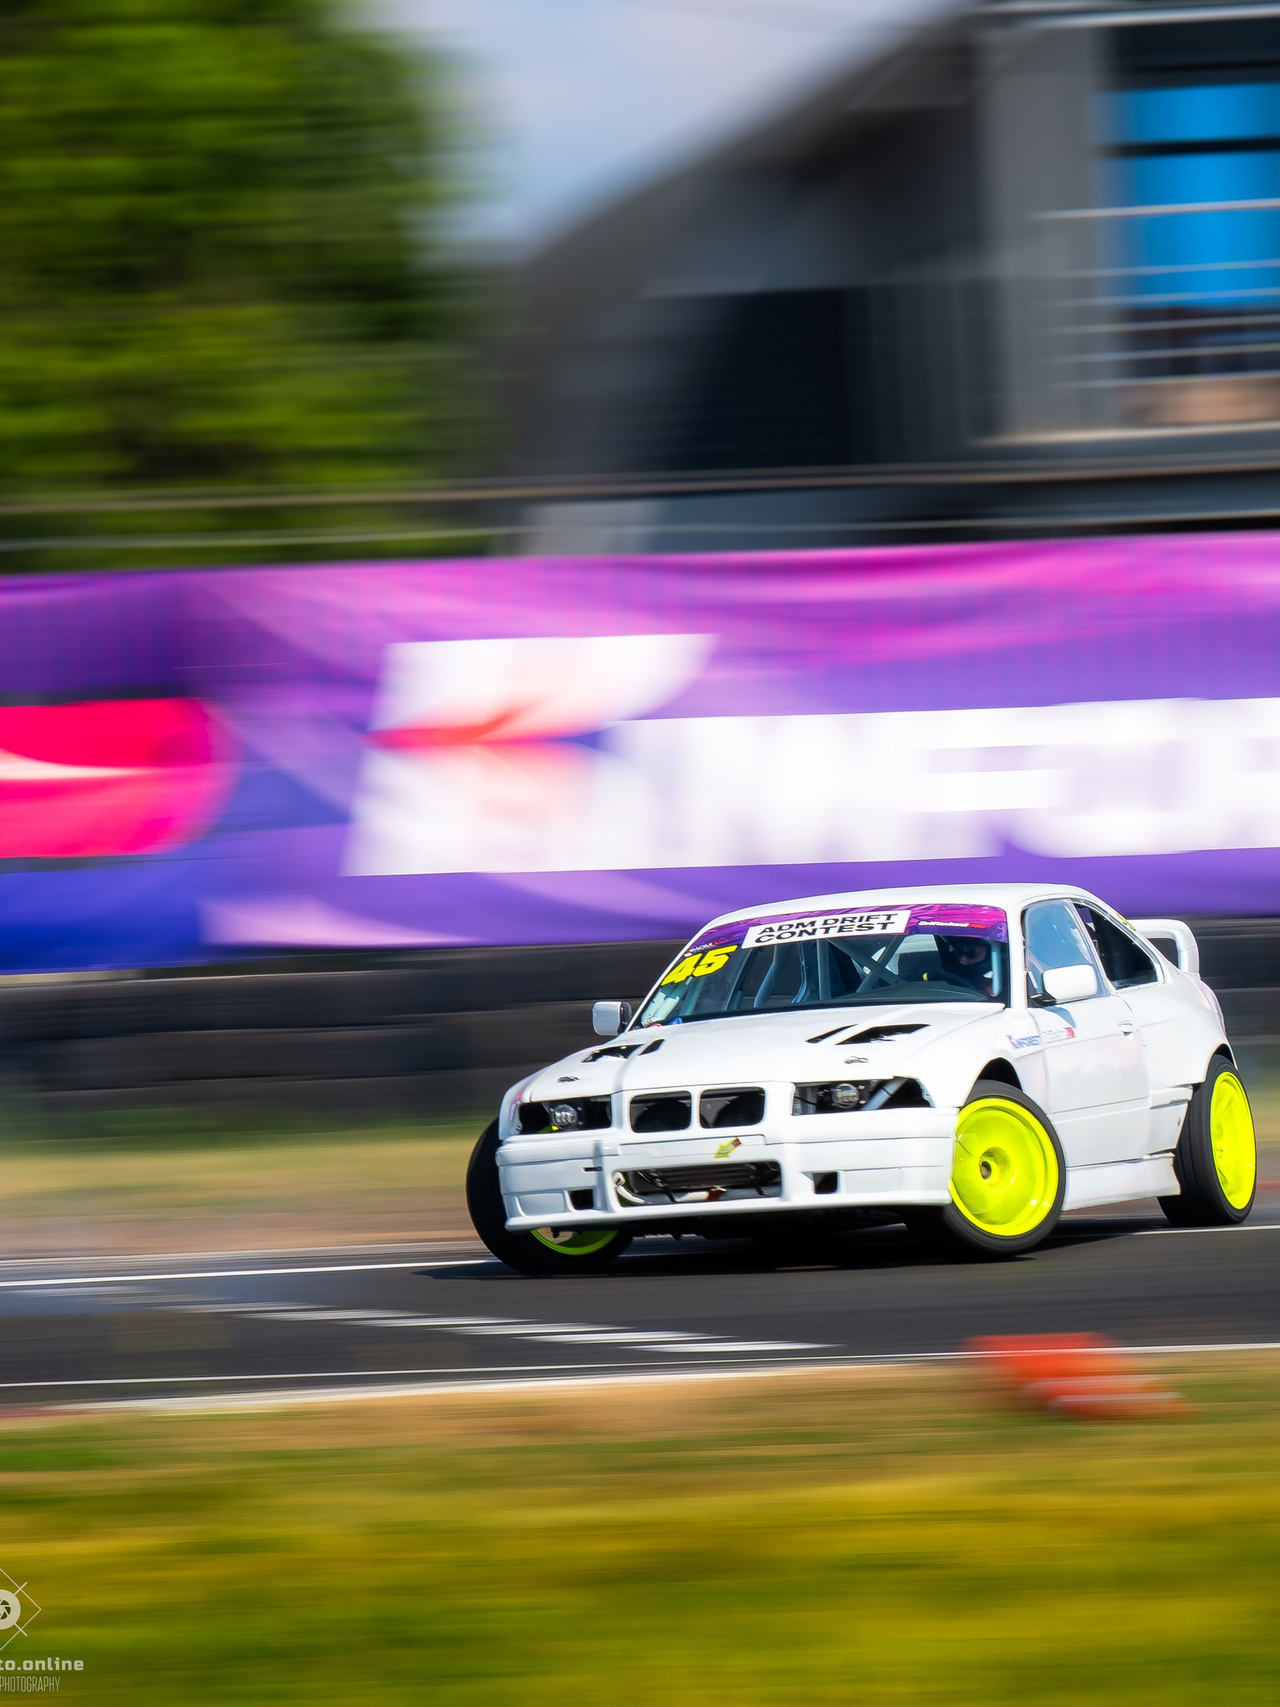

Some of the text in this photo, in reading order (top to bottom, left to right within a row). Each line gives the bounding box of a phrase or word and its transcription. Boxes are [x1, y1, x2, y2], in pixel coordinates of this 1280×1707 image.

[754, 922, 896, 944] CONTEST
[758, 913, 899, 935] ADM DRIFT
[660, 944, 739, 987] 45
